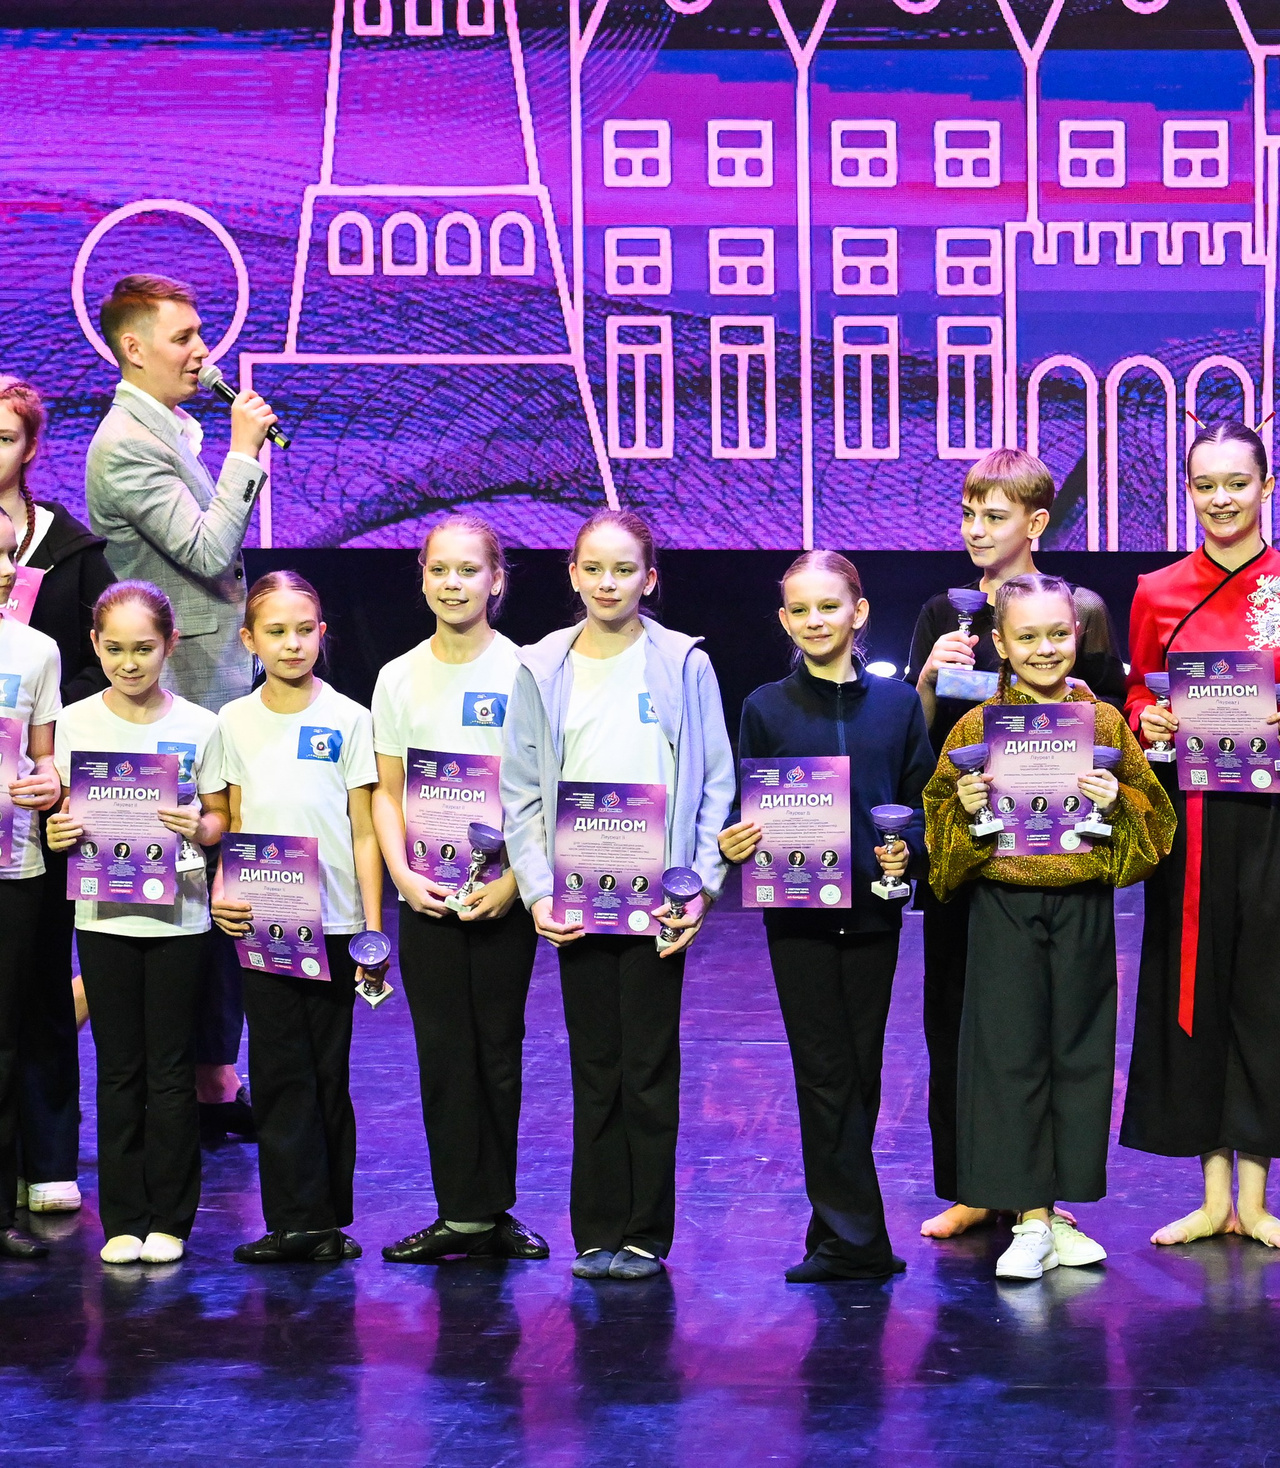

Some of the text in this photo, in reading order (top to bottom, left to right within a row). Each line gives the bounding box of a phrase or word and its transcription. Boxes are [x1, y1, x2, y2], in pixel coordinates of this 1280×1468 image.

[1187, 685, 1258, 699] ДИПЛОМ
[1004, 740, 1076, 755] ДИПЛОМ
[88, 786, 160, 801] ДИПЛОМ
[419, 785, 485, 803] ДИПЛОМ
[760, 793, 833, 809] ДИПЛОМ
[574, 818, 646, 832] ДИПЛОМ
[240, 868, 304, 884] ДИПЛОМ
